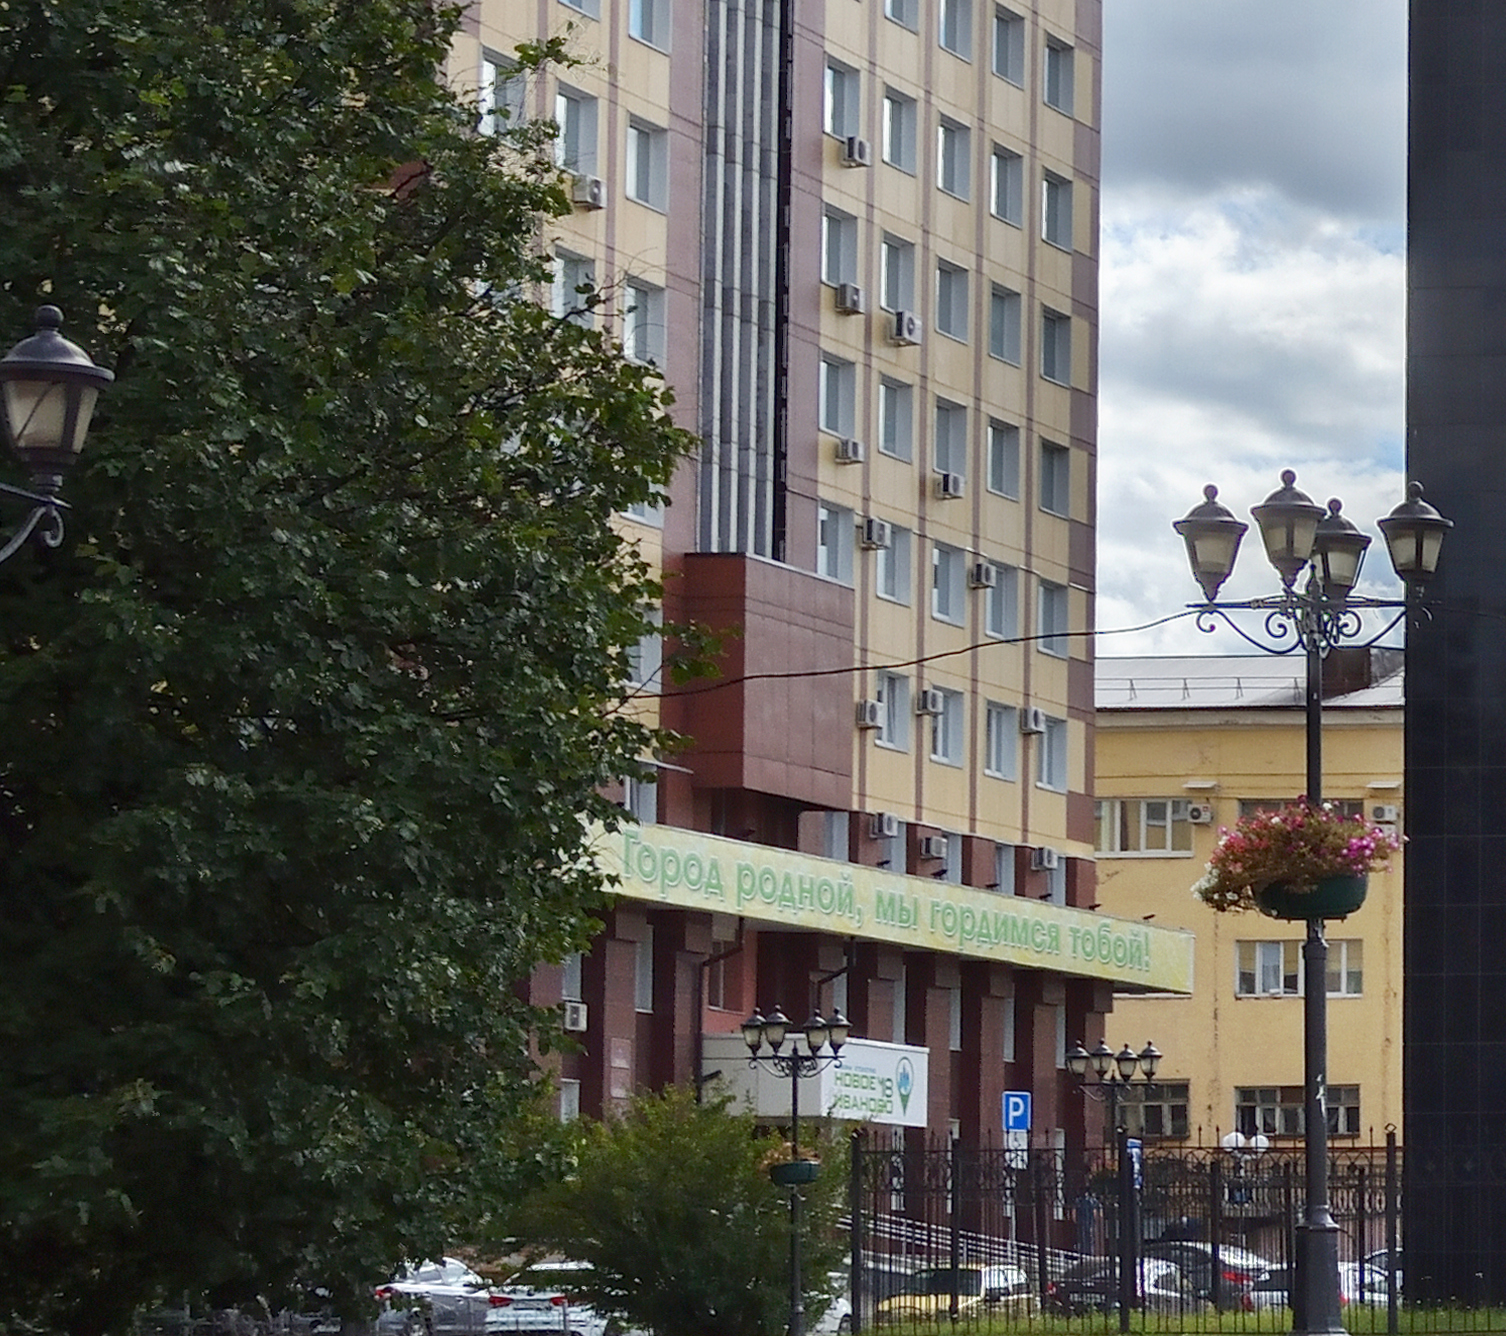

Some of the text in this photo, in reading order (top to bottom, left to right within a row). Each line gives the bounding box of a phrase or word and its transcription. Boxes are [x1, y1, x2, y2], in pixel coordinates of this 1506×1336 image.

[622, 828, 1150, 971] Город родной, мы гордимся тобой!
[835, 1071, 876, 1091] НОВОЕ
